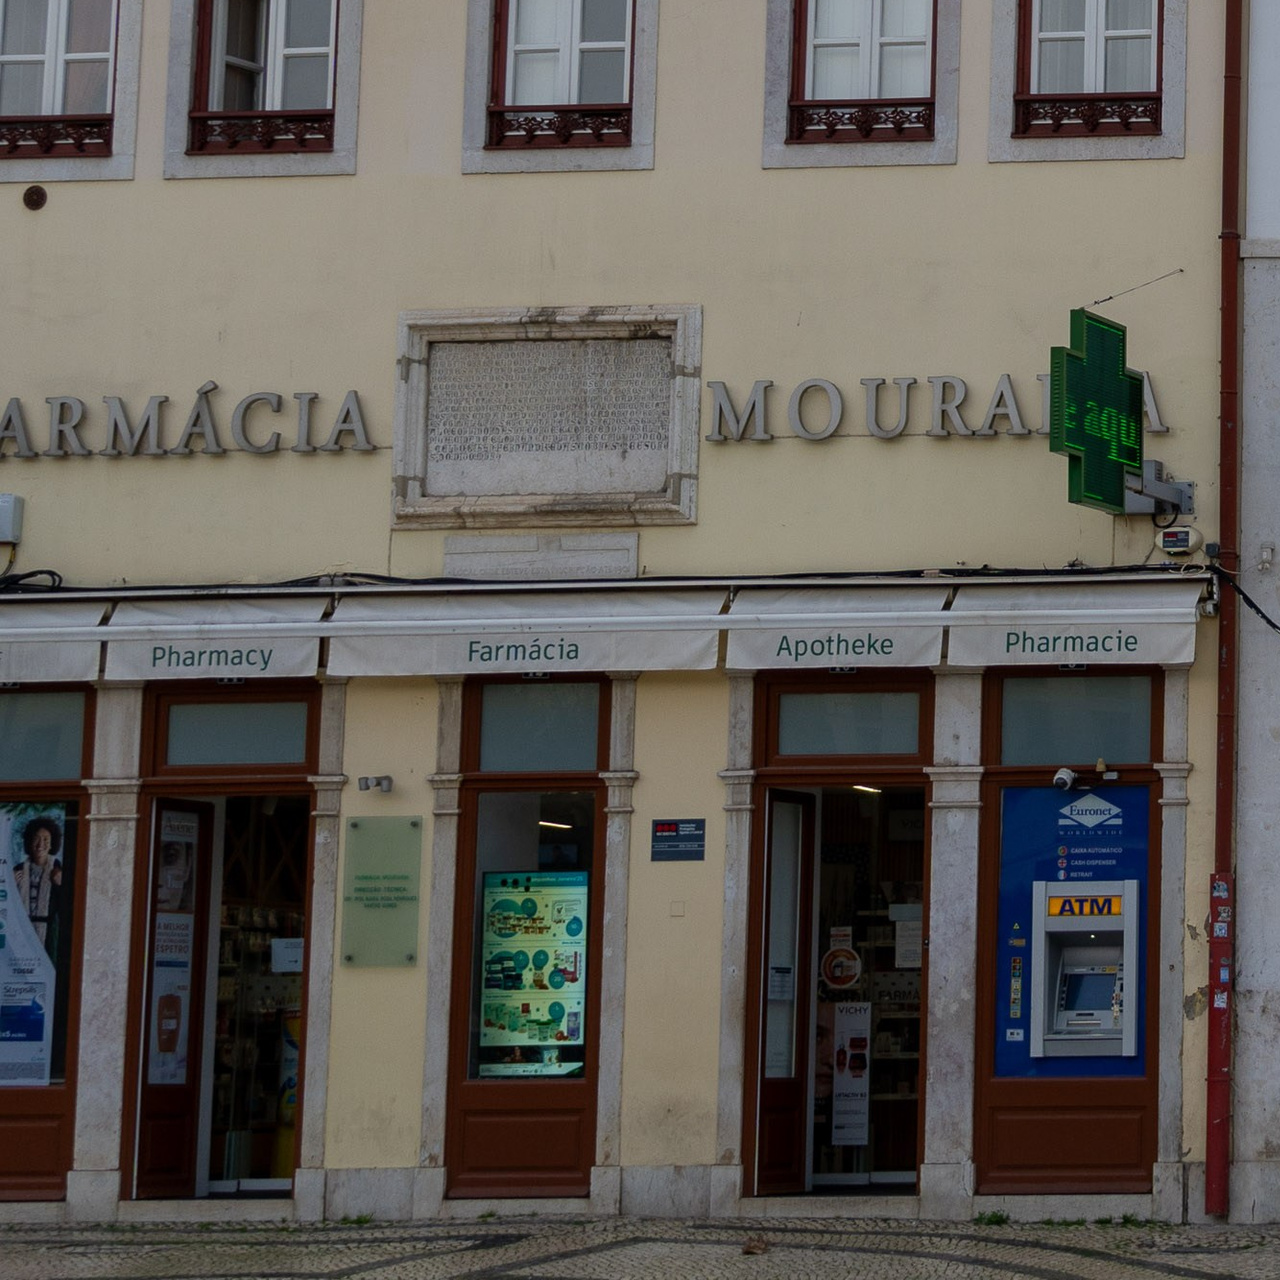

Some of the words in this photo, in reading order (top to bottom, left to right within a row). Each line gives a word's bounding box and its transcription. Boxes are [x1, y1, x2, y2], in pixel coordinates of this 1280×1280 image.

[468, 638, 579, 662] Farmácia
[776, 633, 894, 662] Apotheke
[1006, 630, 1138, 653] Pharmacie
[152, 645, 273, 671] Pharmacy
[1069, 805, 1112, 816] Euronet
[1088, 846, 1123, 854] AUTOMÁTICO
[1059, 898, 1112, 916] ATM
[838, 1006, 869, 1015] VICHY
